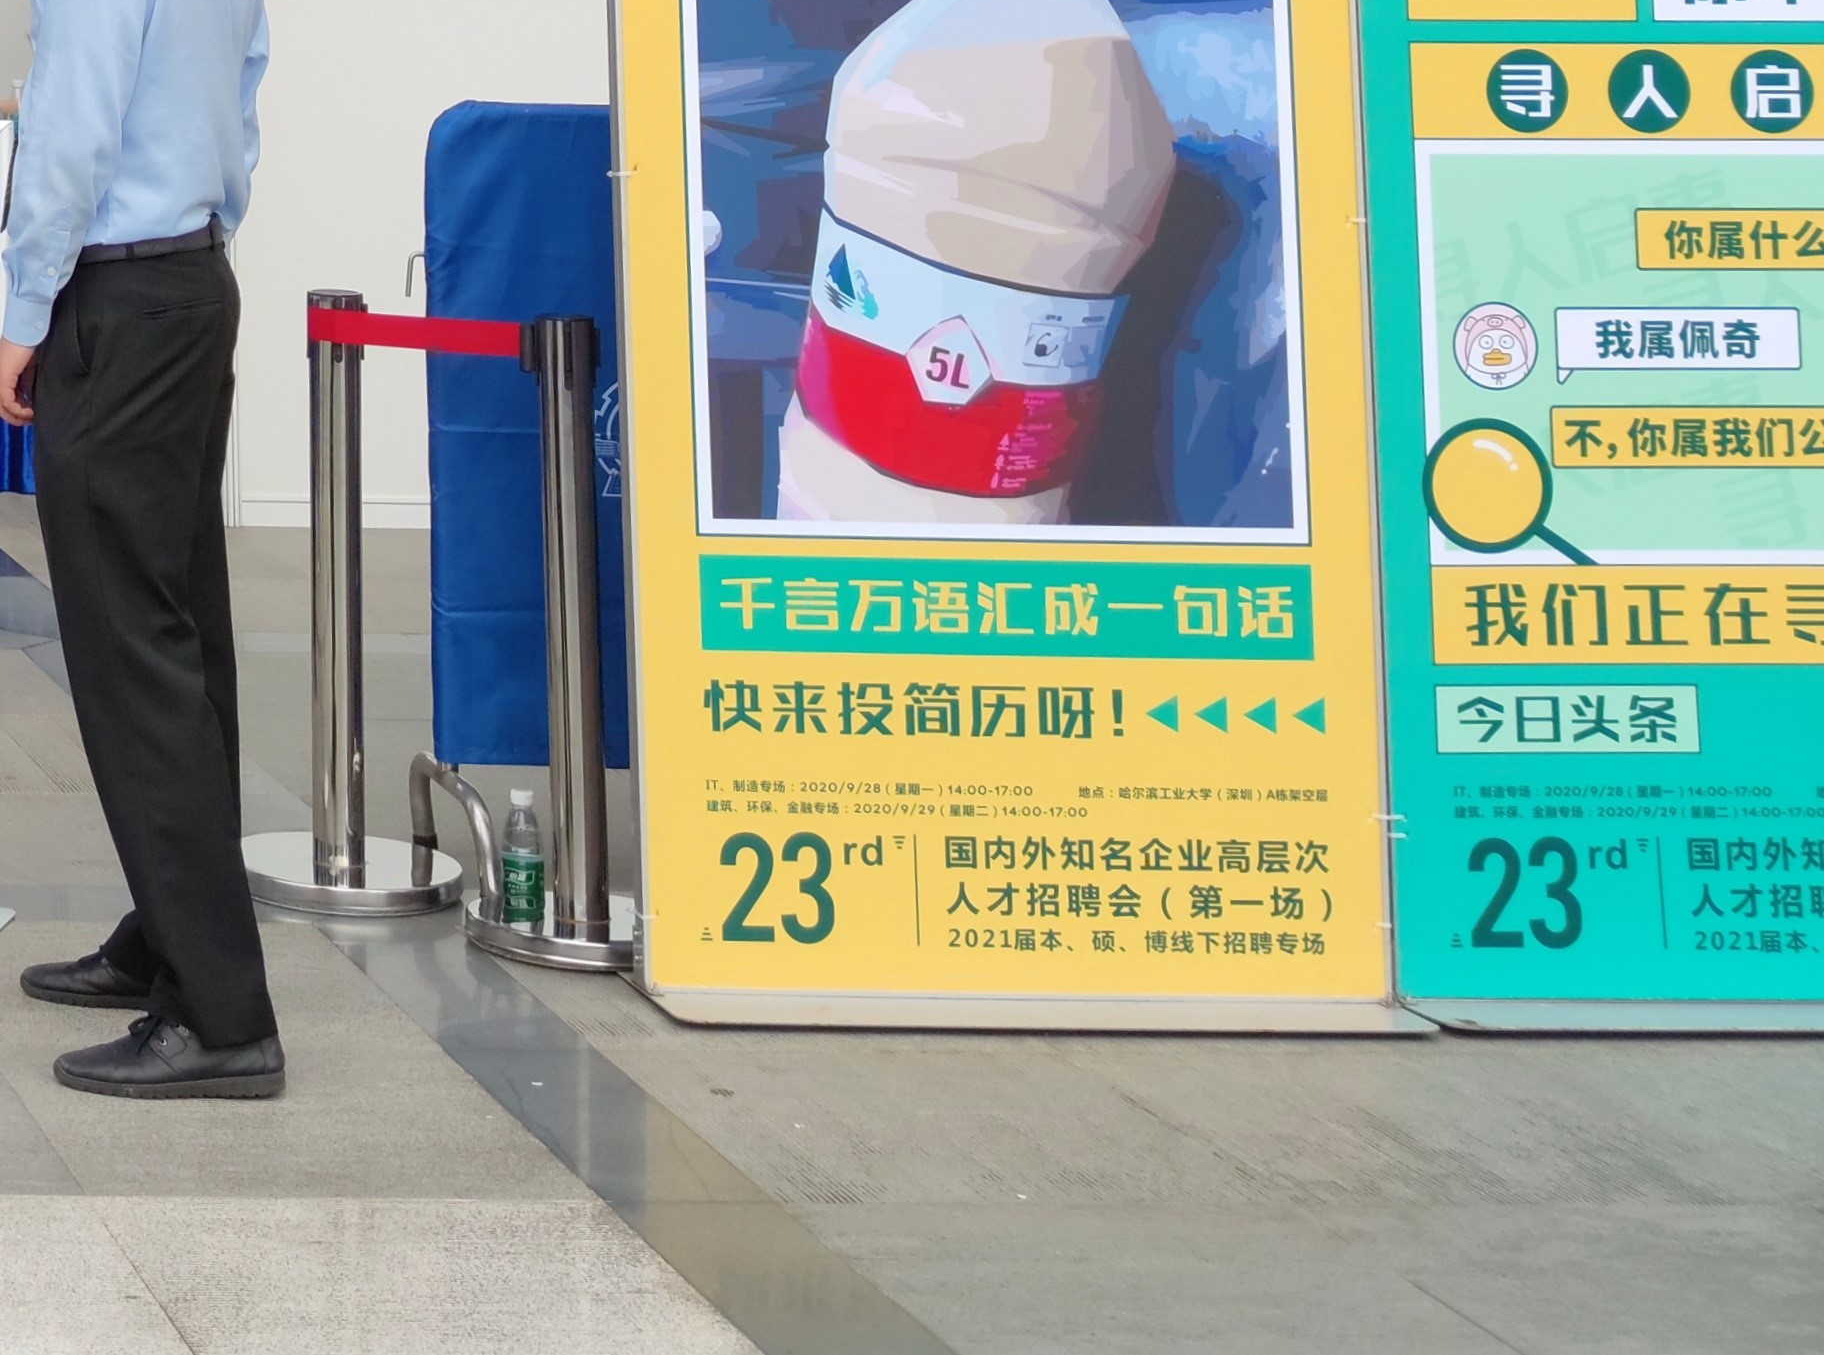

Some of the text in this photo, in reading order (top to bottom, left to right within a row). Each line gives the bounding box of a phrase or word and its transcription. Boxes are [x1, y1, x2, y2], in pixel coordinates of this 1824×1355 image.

[1664, 220, 1824, 261] 你属什么
[1595, 319, 1761, 359] 我属佩奇
[925, 345, 970, 389] 5L
[719, 577, 1295, 639] 千言万语汇成一句话
[703, 678, 1126, 739] 快来投简历呀！
[1457, 694, 1678, 743] 今日头条
[944, 835, 1331, 874] 国内外知名企业高层次
[946, 880, 1334, 921] 人才招聘会（第一场）
[948, 928, 1326, 956] 2021届本、硕、博线下招聘专场
